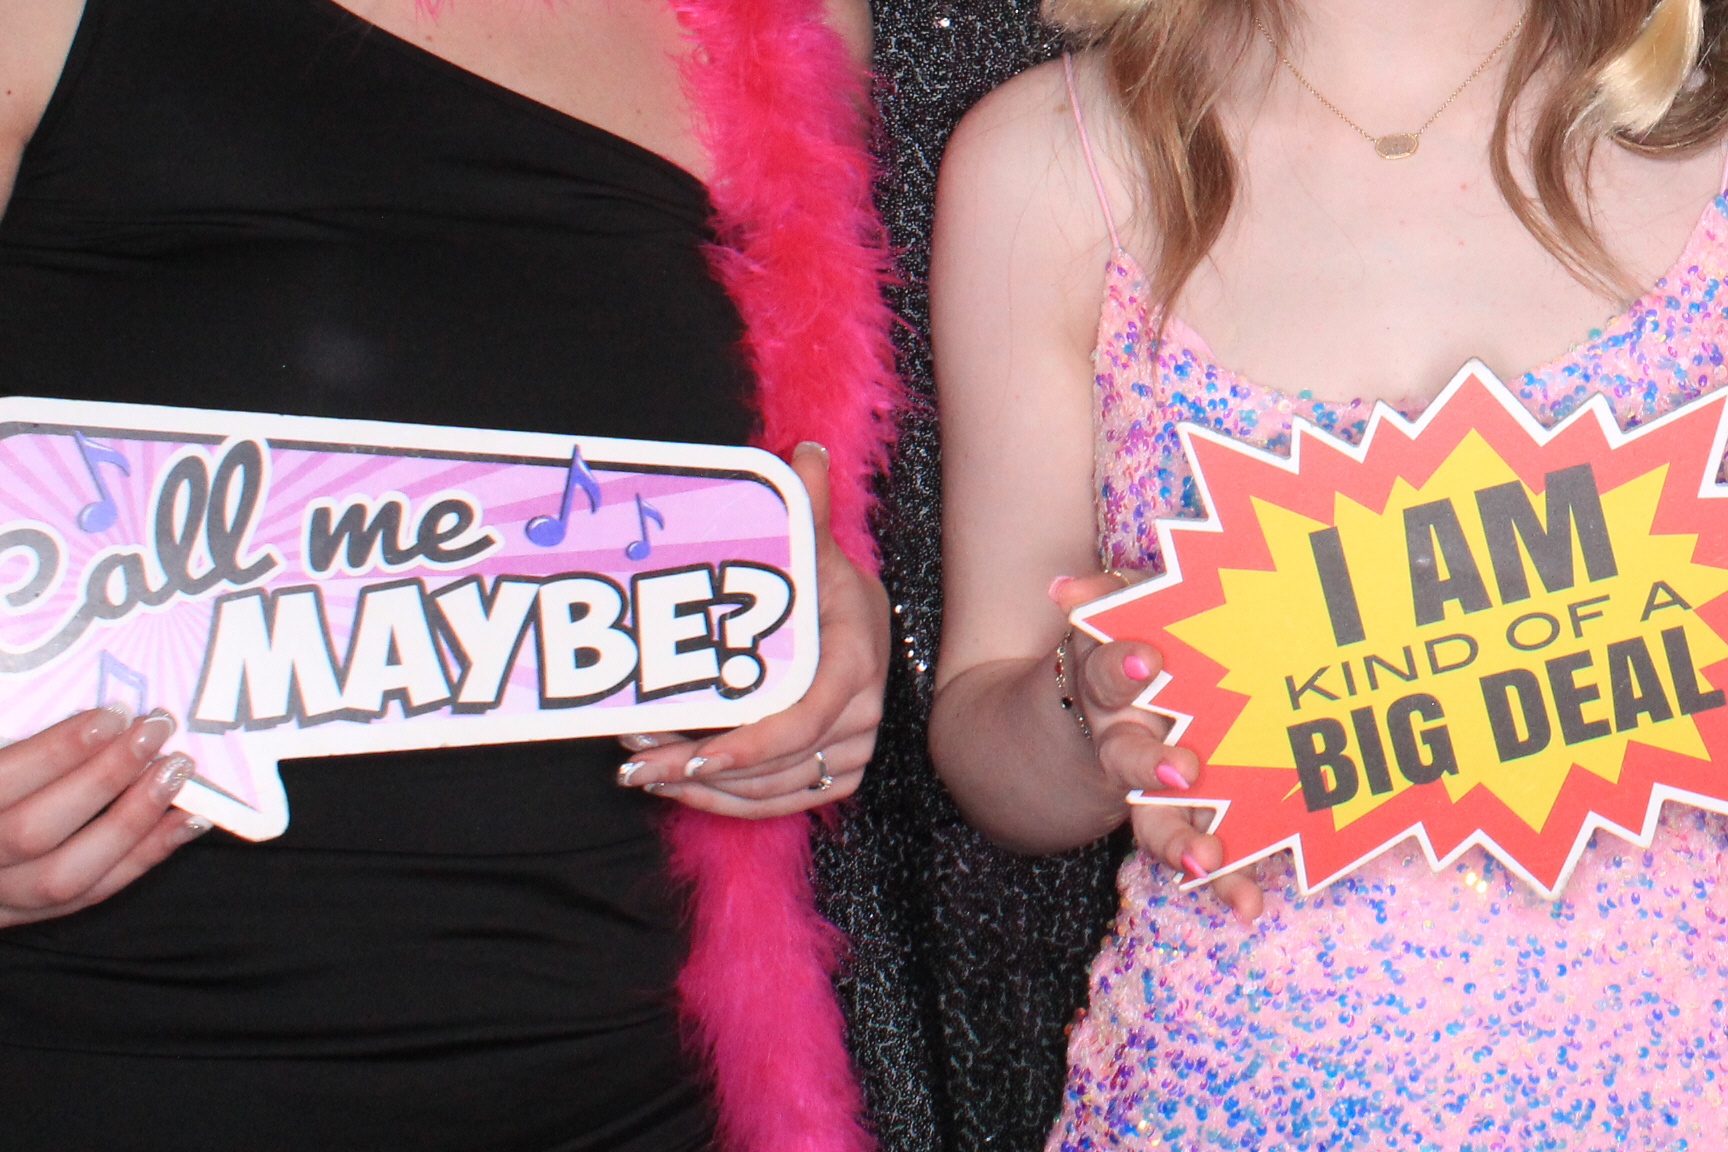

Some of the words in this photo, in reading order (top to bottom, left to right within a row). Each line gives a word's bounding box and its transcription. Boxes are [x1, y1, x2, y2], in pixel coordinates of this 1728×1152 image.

[309, 497, 495, 572] me
[1308, 525, 1366, 647] I
[1402, 462, 1618, 627] AM
[190, 561, 795, 732] MAYBE?
[1284, 633, 1478, 710] KIND
[1505, 594, 1611, 652] OF
[1640, 580, 1694, 621] A
[1286, 692, 1460, 814] BIG
[1479, 625, 1727, 764] DEAL
